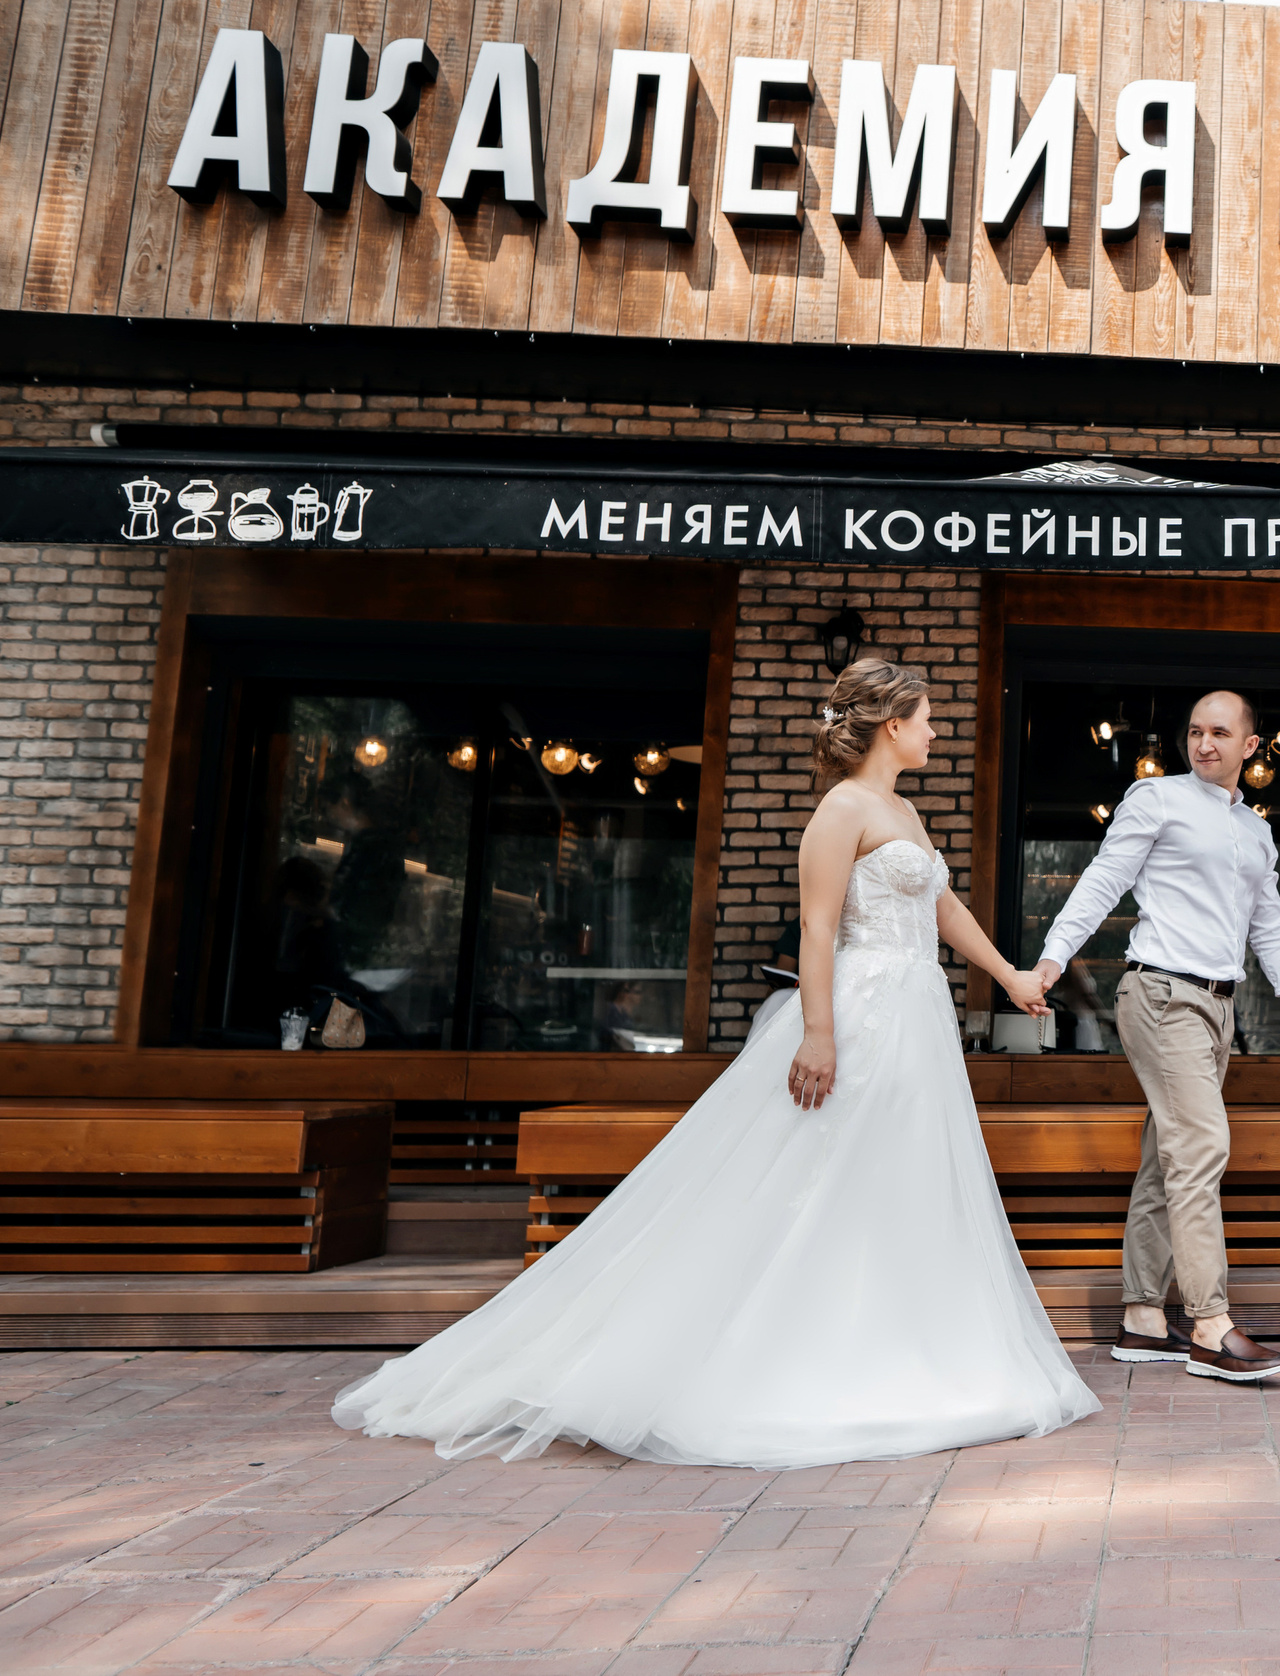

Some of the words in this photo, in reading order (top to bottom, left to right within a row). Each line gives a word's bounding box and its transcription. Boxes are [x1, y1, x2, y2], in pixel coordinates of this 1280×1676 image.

[168, 29, 1196, 242] АКАДЕМИЯ
[540, 498, 803, 547] МЕНЯЕМ
[845, 508, 1182, 556] КОФЕЙНЫЕ
